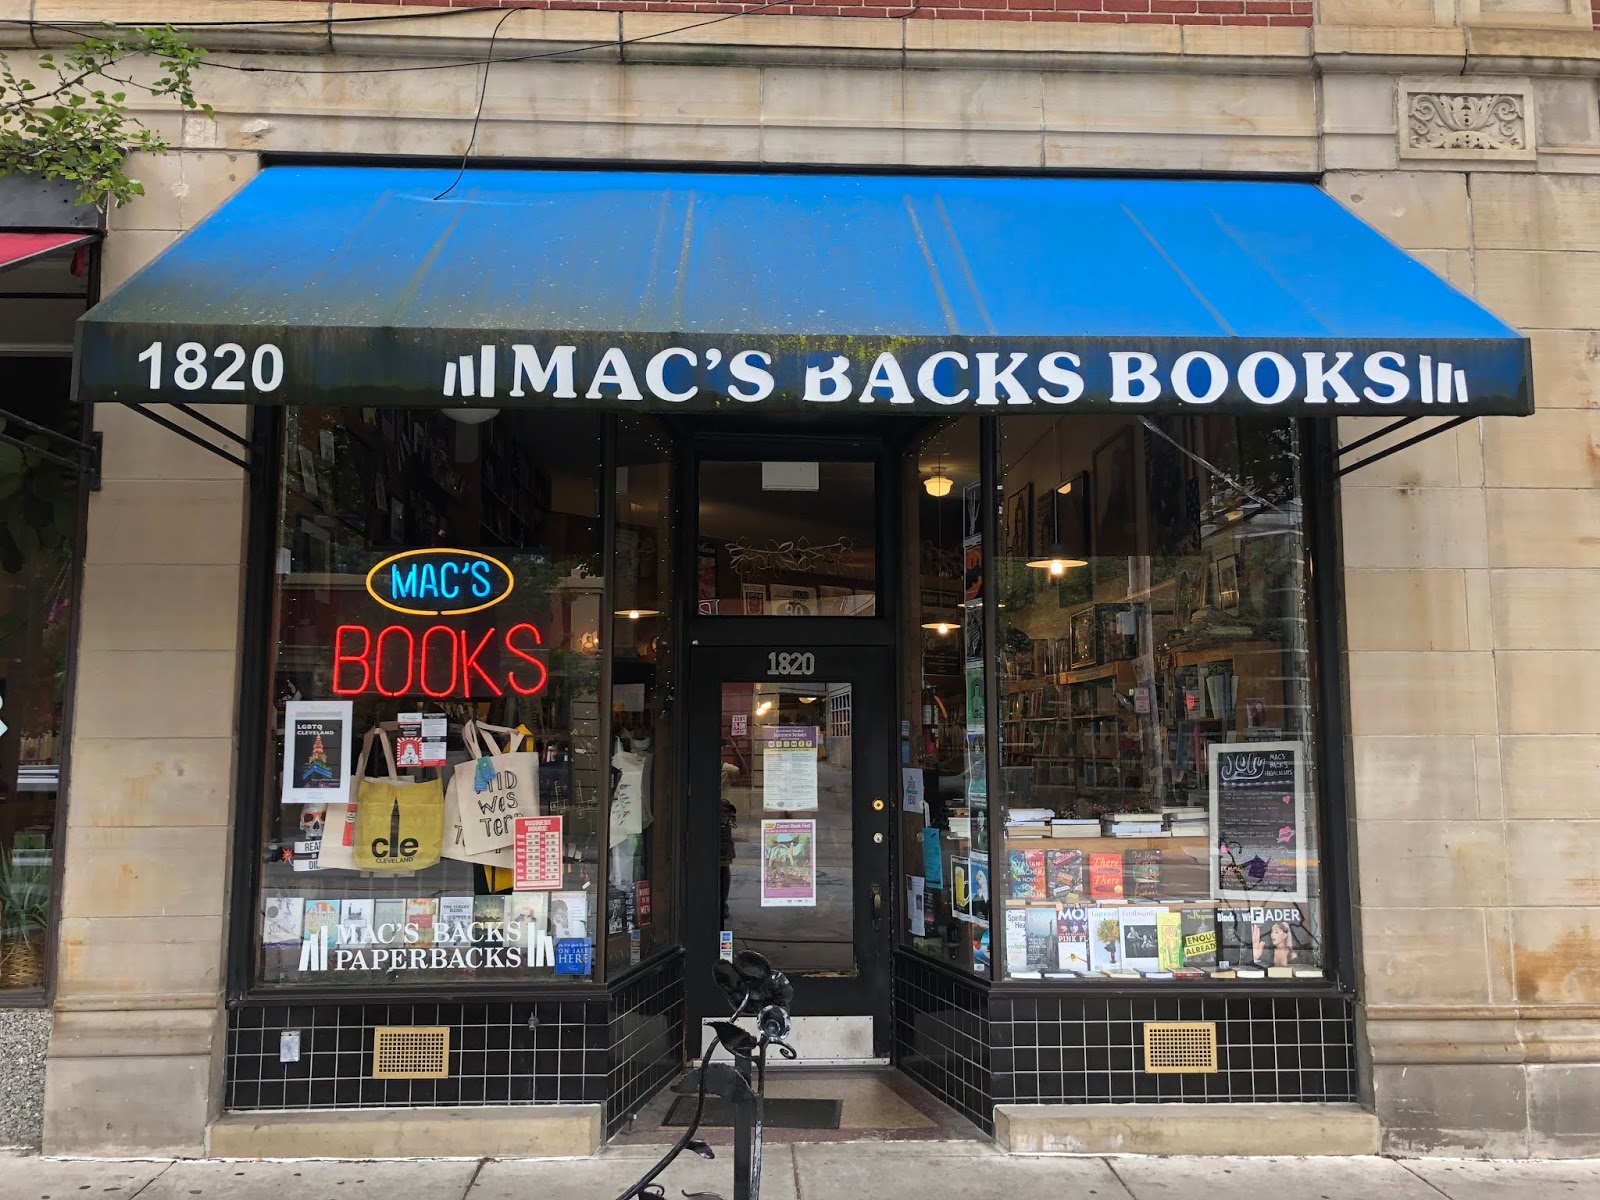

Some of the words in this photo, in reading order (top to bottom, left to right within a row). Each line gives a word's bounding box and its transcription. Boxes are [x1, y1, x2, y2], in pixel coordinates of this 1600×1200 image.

[138, 341, 284, 392] 1820
[509, 344, 775, 403] MAC'S
[802, 351, 1085, 405] BACKS
[1109, 351, 1410, 404] BOOKS
[392, 561, 491, 599] MAC'S
[332, 623, 547, 698] BOOKS
[767, 652, 815, 675] 1820
[476, 770, 517, 794] ID
[1092, 857, 1119, 867] There
[1094, 876, 1120, 885] There
[308, 904, 336, 913] ALL
[1217, 912, 1235, 922] Black
[1253, 908, 1300, 922] FADER
[335, 922, 419, 945] MAC'S
[432, 921, 522, 943] BACKS
[334, 947, 522, 971] PAPERBACKS
[1186, 943, 1217, 955] ALREAD
